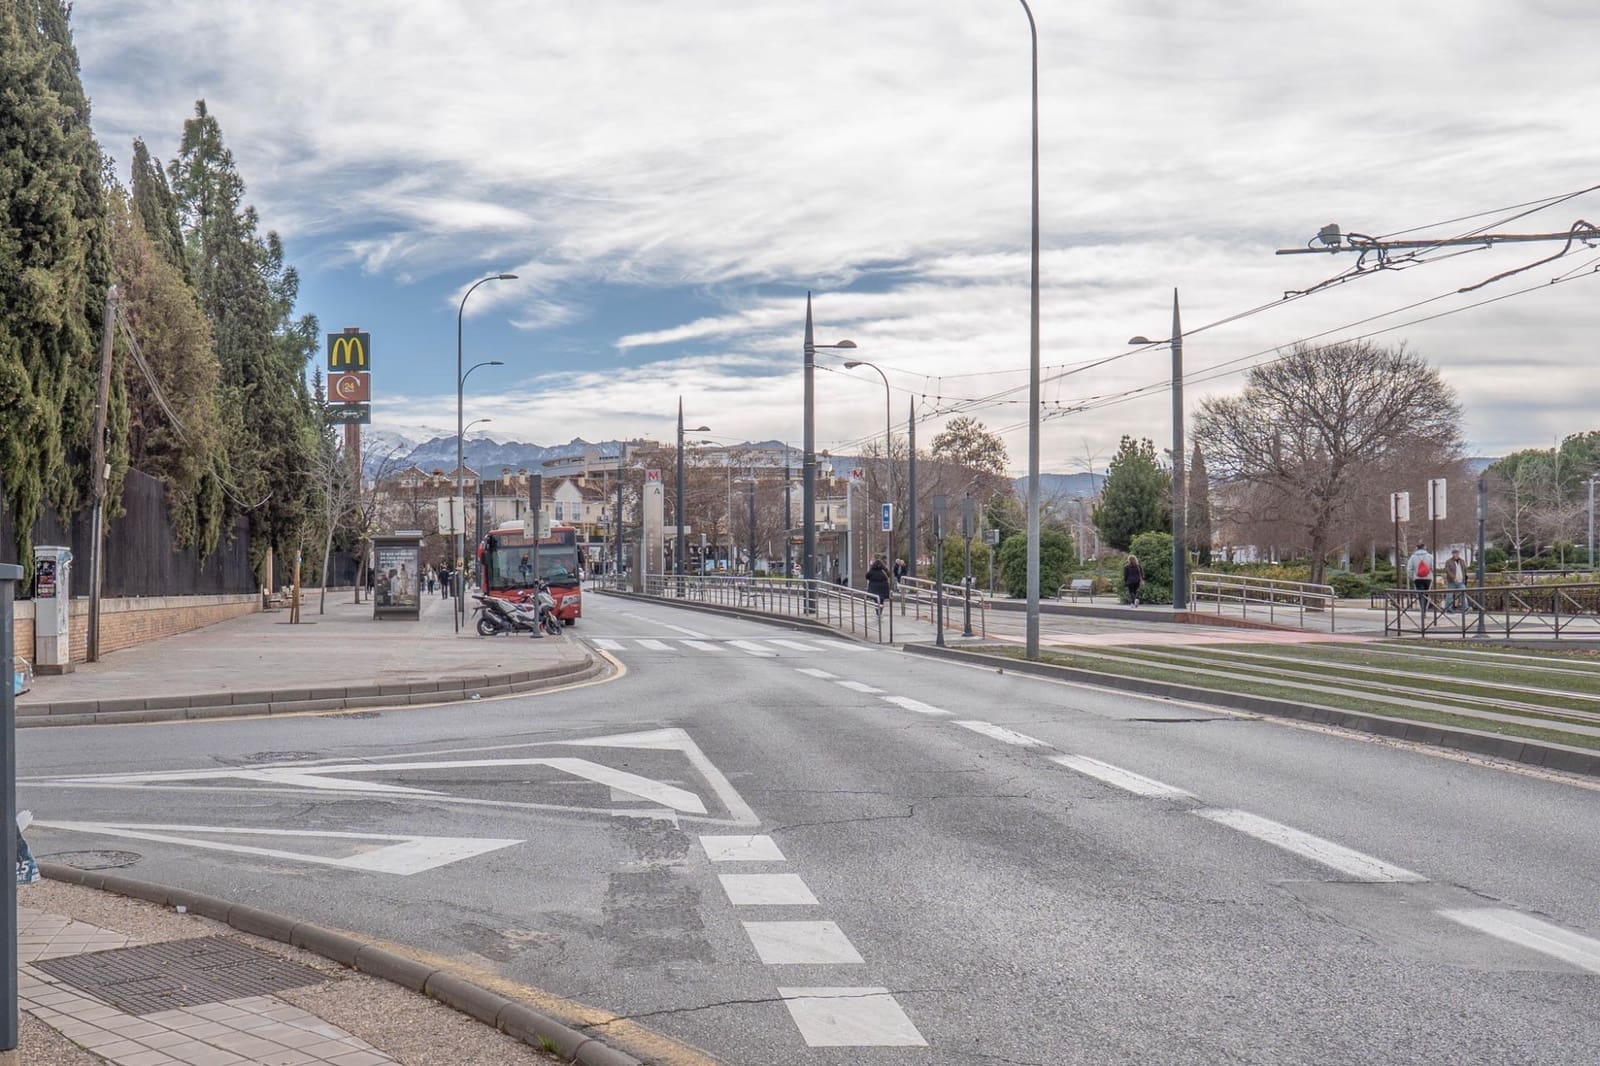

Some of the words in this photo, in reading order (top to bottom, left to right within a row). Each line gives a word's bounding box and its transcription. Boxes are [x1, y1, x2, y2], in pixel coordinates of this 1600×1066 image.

[331, 337, 365, 366] M
[648, 472, 659, 480] M
[853, 469, 863, 479] M
